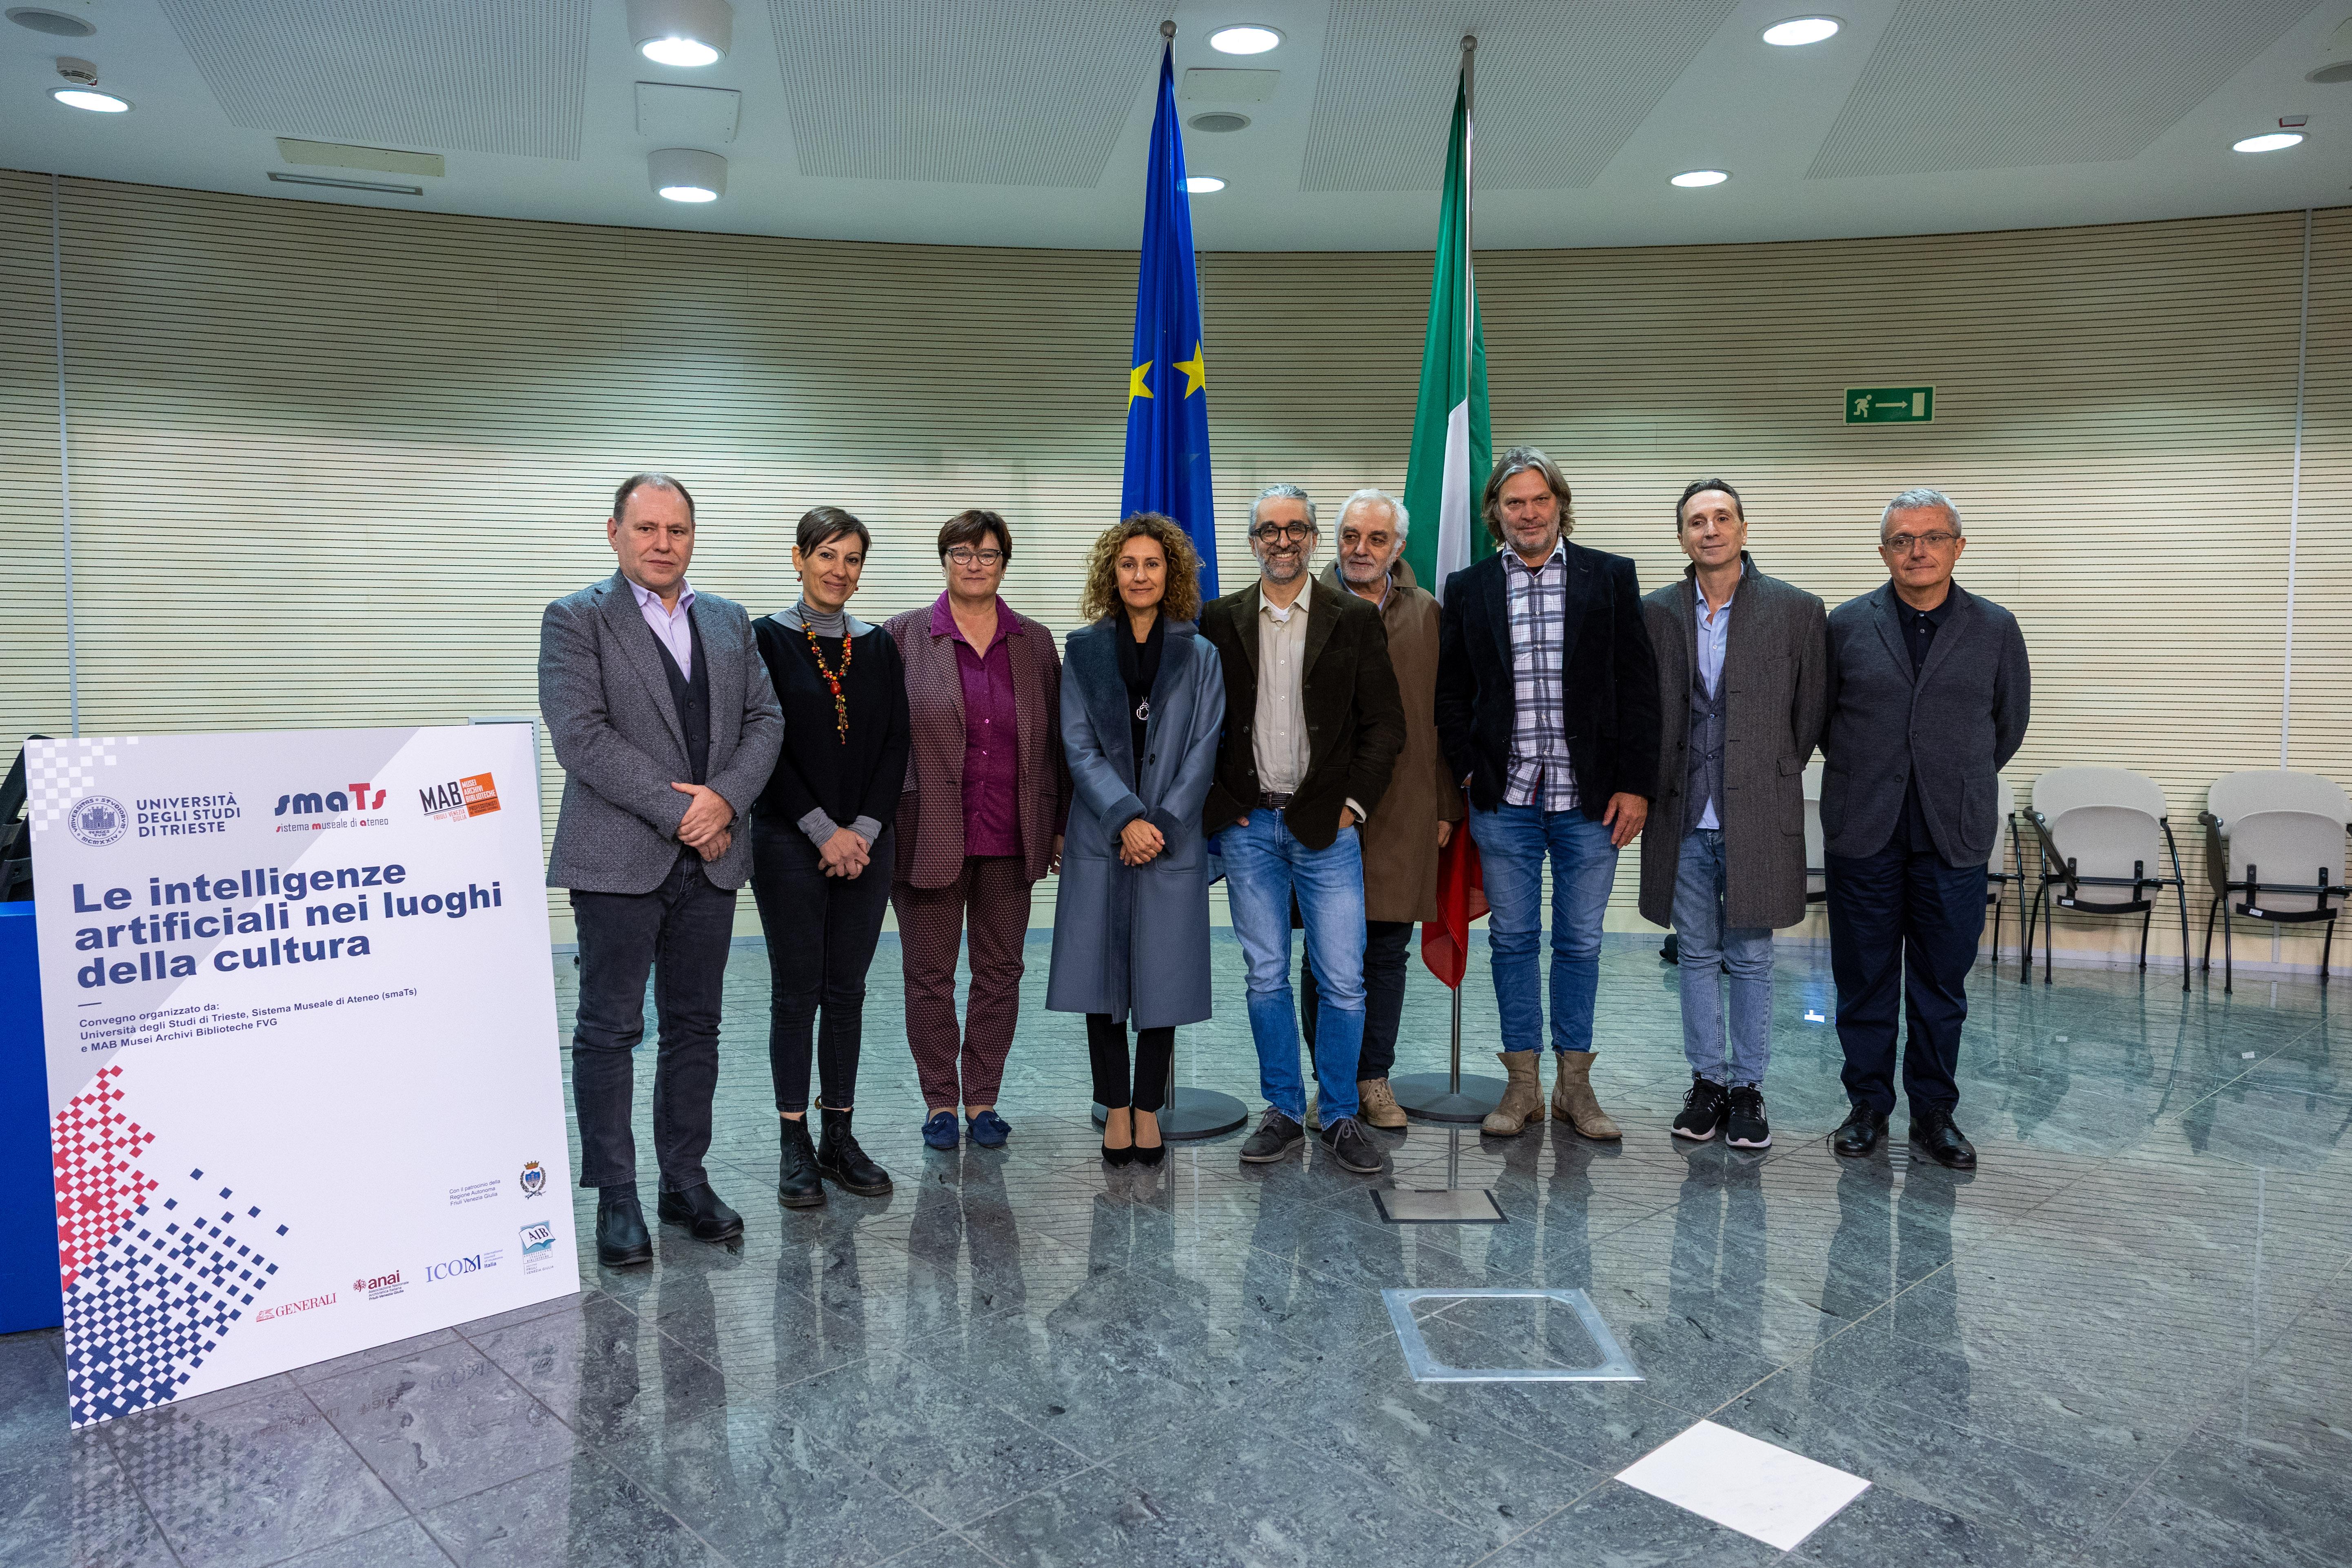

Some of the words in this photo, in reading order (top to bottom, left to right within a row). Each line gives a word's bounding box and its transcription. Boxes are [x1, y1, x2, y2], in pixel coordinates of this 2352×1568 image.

[462, 779, 477, 788] MUSEI
[464, 785, 483, 795] ARCHIVI
[137, 792, 237, 810] UNIVERSITÀ
[275, 783, 386, 816] smaTs
[419, 781, 462, 812] MAB
[466, 789, 496, 803] BIBLIOTECHE
[138, 811, 186, 824] DEGLI
[193, 807, 240, 820] STUDI
[449, 809, 466, 817] VENEZIA
[139, 826, 155, 837] DI
[160, 821, 225, 836] TRIESTE
[276, 824, 309, 833] sistema
[312, 818, 347, 830] museale
[351, 818, 357, 827] di
[360, 818, 388, 826] ateneo
[82, 834, 118, 845] MCMXXIV
[73, 883, 132, 913] Le
[151, 864, 406, 901] intelligenze
[75, 902, 289, 950] artificiali
[306, 894, 369, 927] nei
[384, 881, 502, 918] luoghi
[77, 950, 197, 988] della
[214, 935, 371, 971] cultura
[80, 1026, 136, 1040] Università
[140, 1022, 165, 1032] degli
[169, 1017, 196, 1028] Studi
[212, 1011, 249, 1022] Trieste,
[252, 1006, 291, 1016] Sistema
[294, 1000, 333, 1011] Museale
[347, 994, 379, 1004] Ateneo
[382, 988, 417, 1000] (smaTs)
[80, 1014, 135, 1027] Convegno
[139, 1006, 200, 1020] organizzato
[91, 1040, 117, 1051] MAB
[121, 1036, 153, 1047] Musei
[156, 1030, 193, 1042] Archivi
[196, 1022, 253, 1036] Biblioteche
[257, 1018, 277, 1027] FVG
[465, 1182, 488, 1191] patrocinio
[471, 1187, 495, 1195] Autonoma
[528, 1228, 548, 1242] AIB
[425, 1255, 481, 1282] ICOM
[368, 1270, 400, 1289] anai
[276, 1293, 337, 1317] GENERALI
